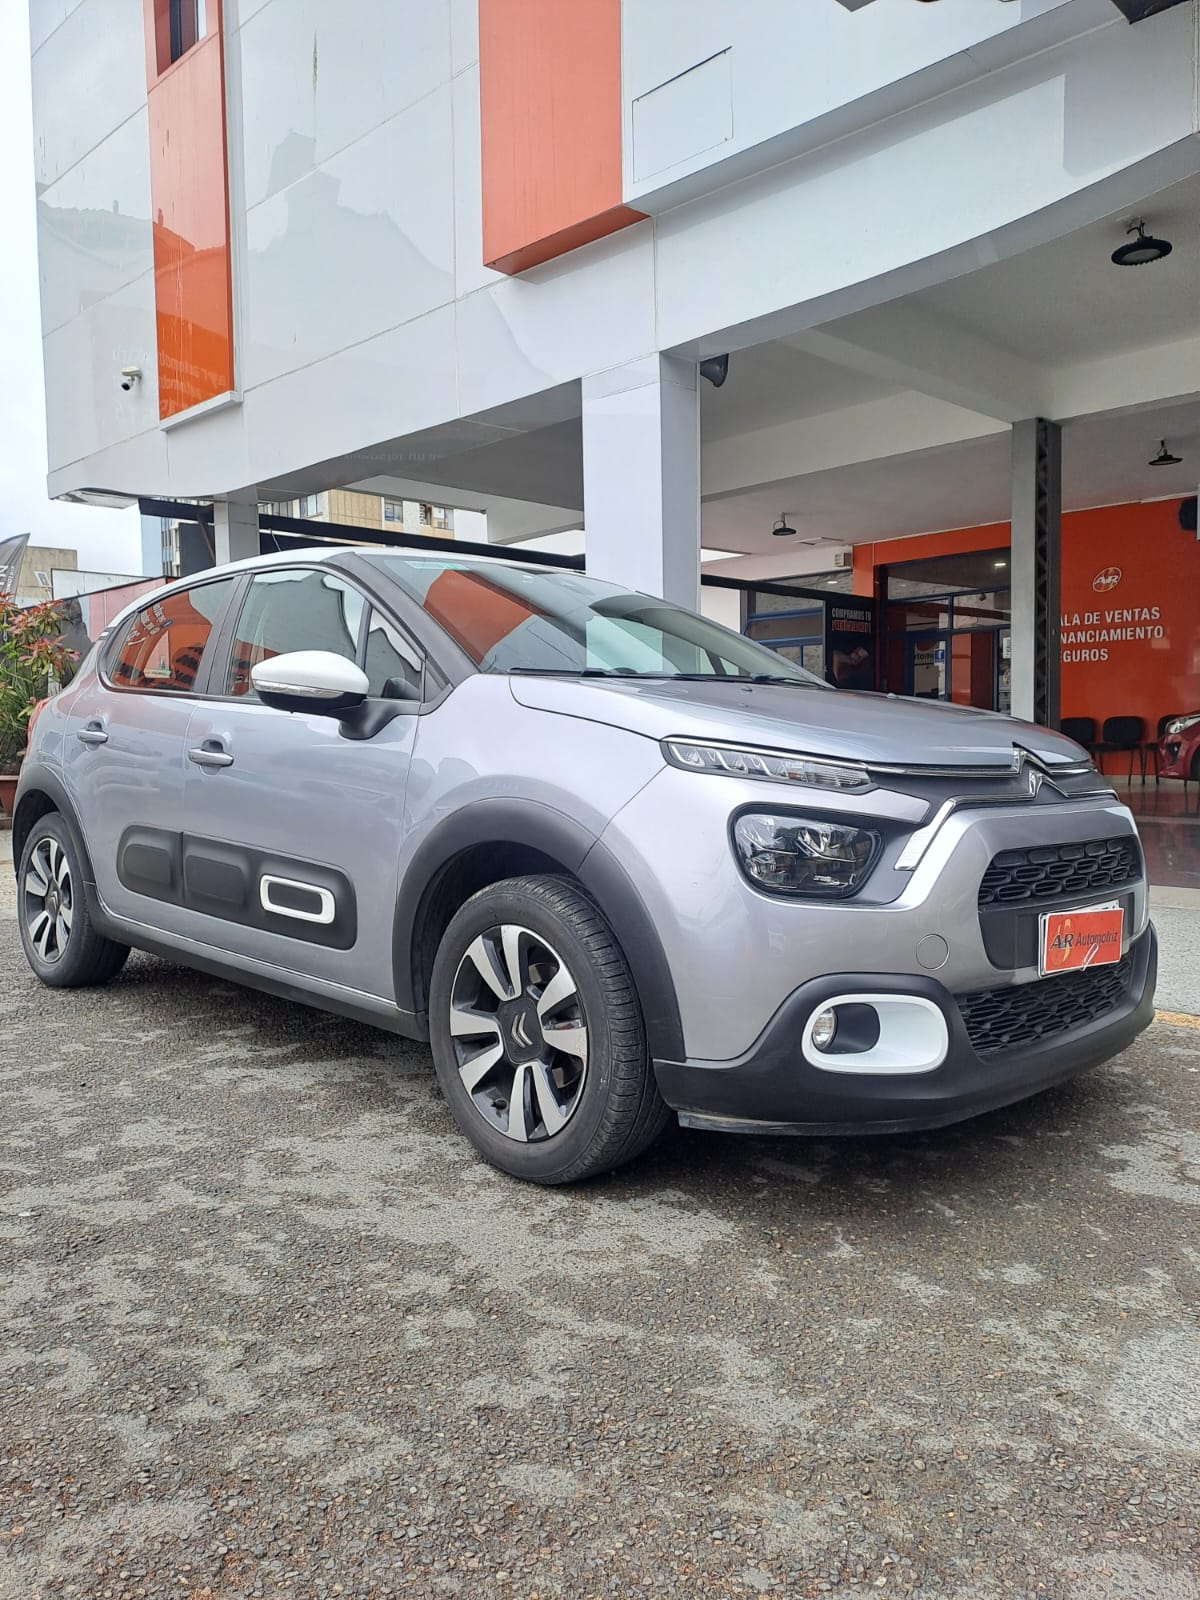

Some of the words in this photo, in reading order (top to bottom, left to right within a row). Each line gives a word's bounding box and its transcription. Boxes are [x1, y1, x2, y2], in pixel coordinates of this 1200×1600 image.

[1084, 612, 1100, 625] DE
[1105, 607, 1160, 623] VENTAS
[1060, 648, 1109, 663] GUROS
[1076, 931, 1118, 947] Automotriz
